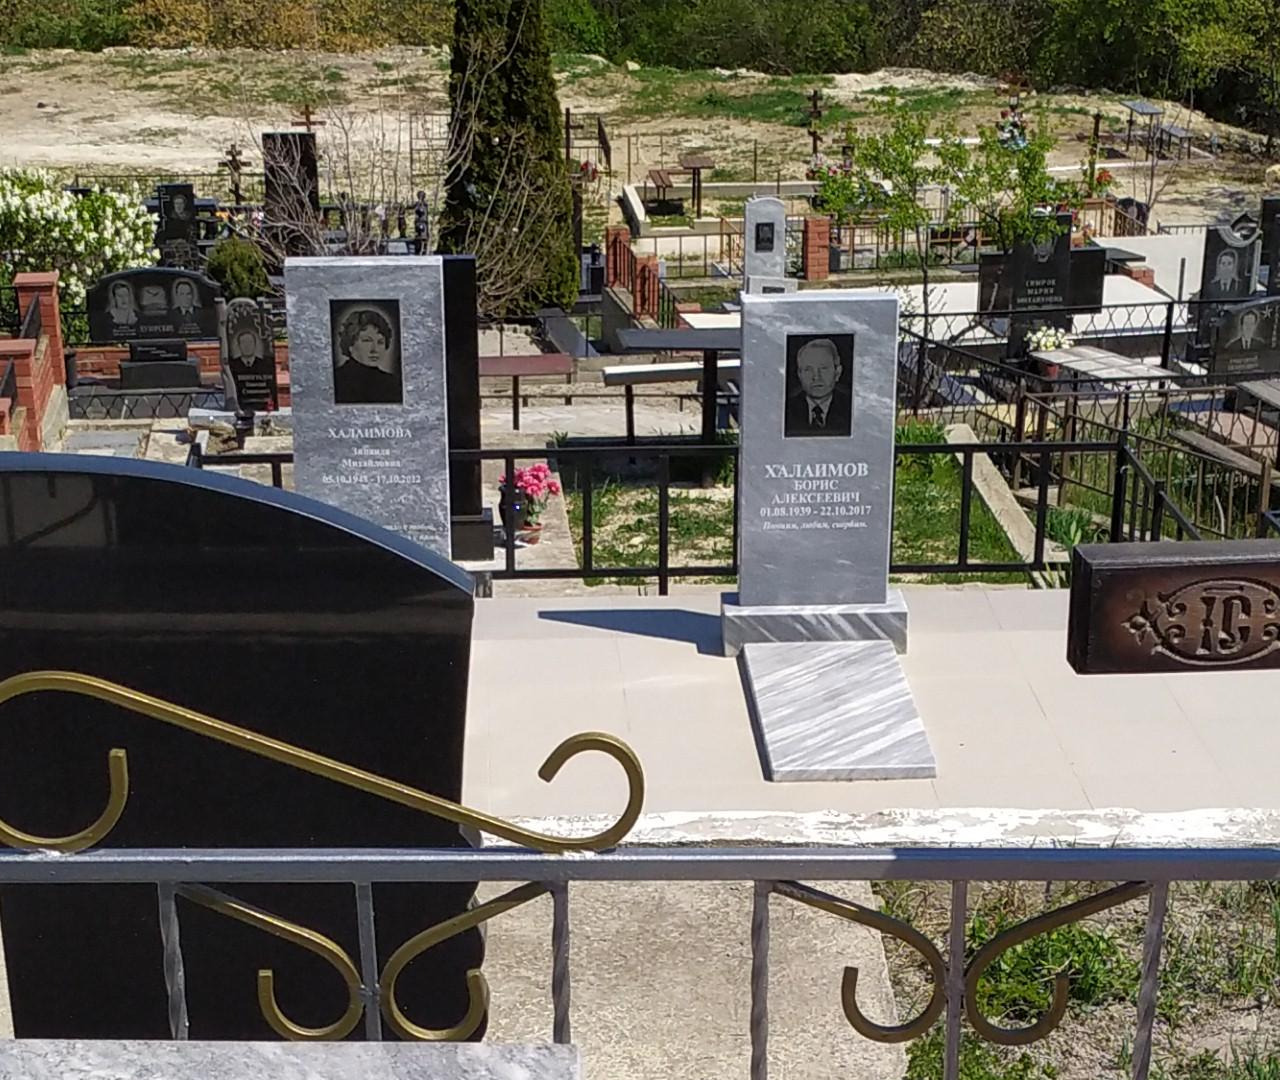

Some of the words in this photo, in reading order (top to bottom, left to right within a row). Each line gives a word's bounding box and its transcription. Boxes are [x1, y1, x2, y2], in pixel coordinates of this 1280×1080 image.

[764, 462, 869, 478] ХАЛАИМОВ
[794, 479, 839, 491] БОРИС
[771, 491, 860, 504] АЛЕКСЕЕВИЧ
[820, 505, 872, 516] 22.10.2017
